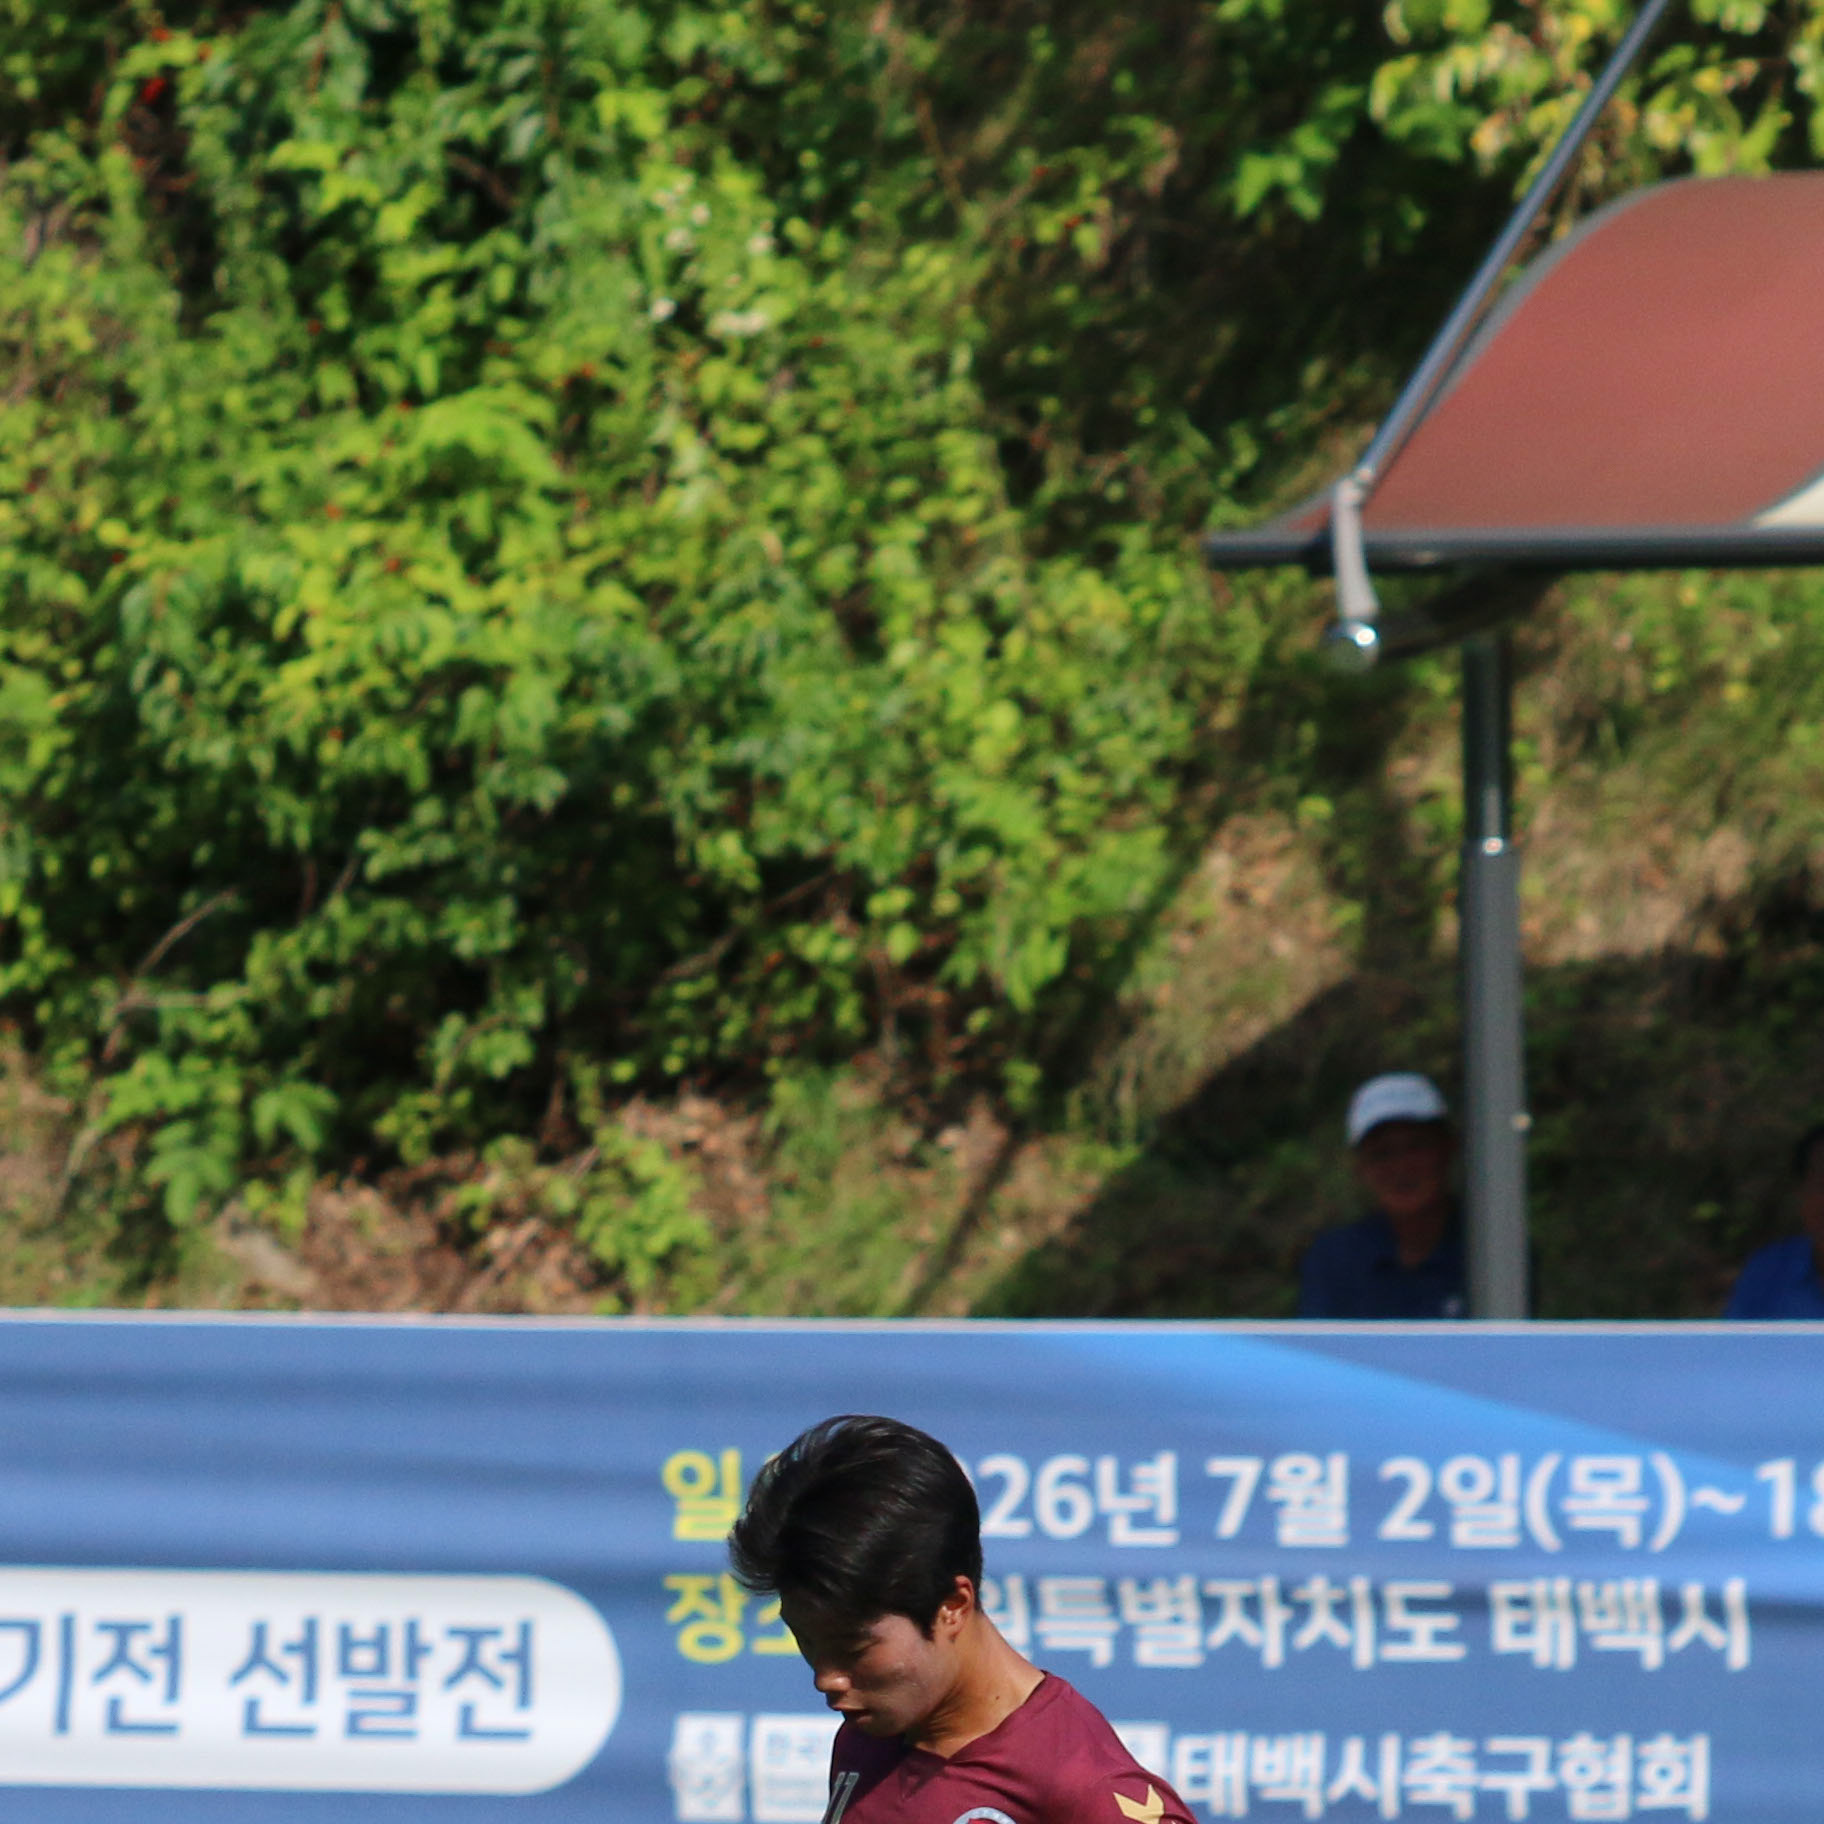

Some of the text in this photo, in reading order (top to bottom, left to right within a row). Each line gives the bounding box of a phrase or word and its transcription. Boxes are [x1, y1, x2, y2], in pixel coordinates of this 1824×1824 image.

[662, 1448, 778, 1541] 일
[961, 1452, 1178, 1547] 26년
[1205, 1454, 1349, 1548] 7월
[980, 1575, 1466, 1668] 특별자치도
[1489, 1578, 1751, 1670] 태백시
[229, 1616, 534, 1741] 선발전
[1175, 1732, 1710, 1819] 태백시축구협회
